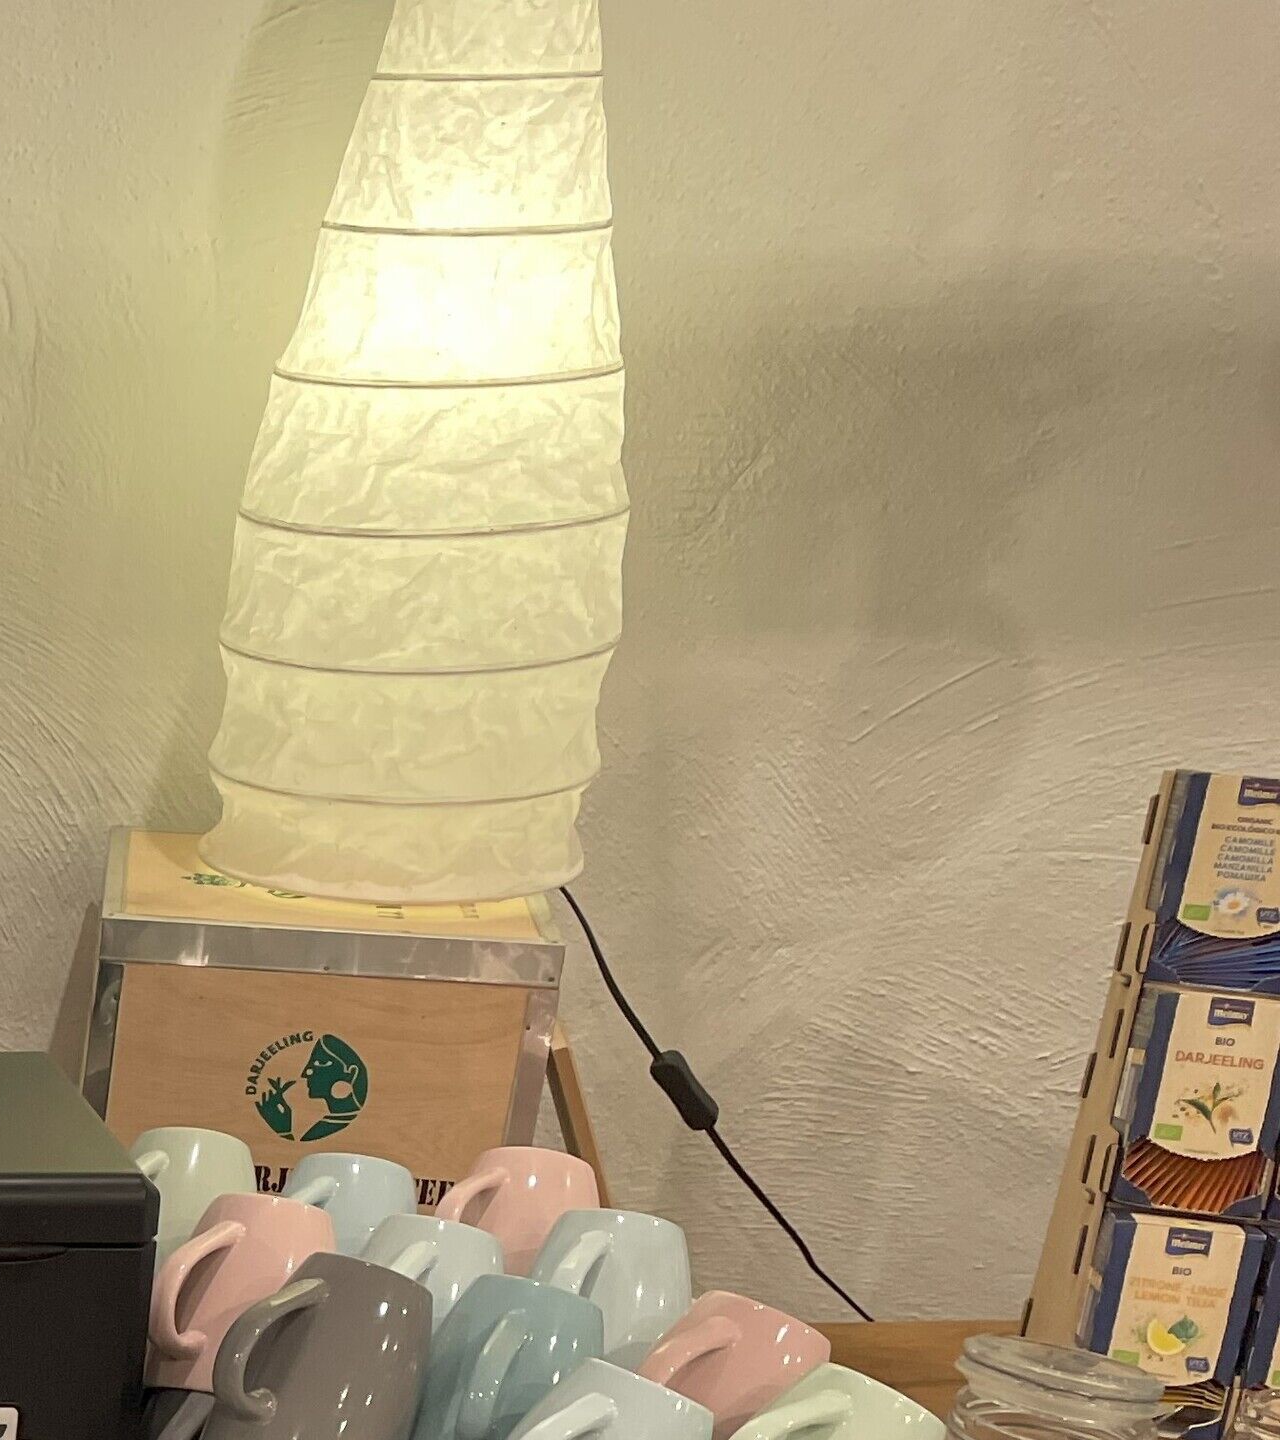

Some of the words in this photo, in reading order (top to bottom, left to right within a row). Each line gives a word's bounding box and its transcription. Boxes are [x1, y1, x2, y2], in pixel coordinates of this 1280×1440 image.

[1215, 1036, 1236, 1047] BIO
[245, 1030, 314, 1096] DARJEELING
[1175, 1050, 1266, 1071] DARJEELING
[1171, 1266, 1193, 1277] BIO
